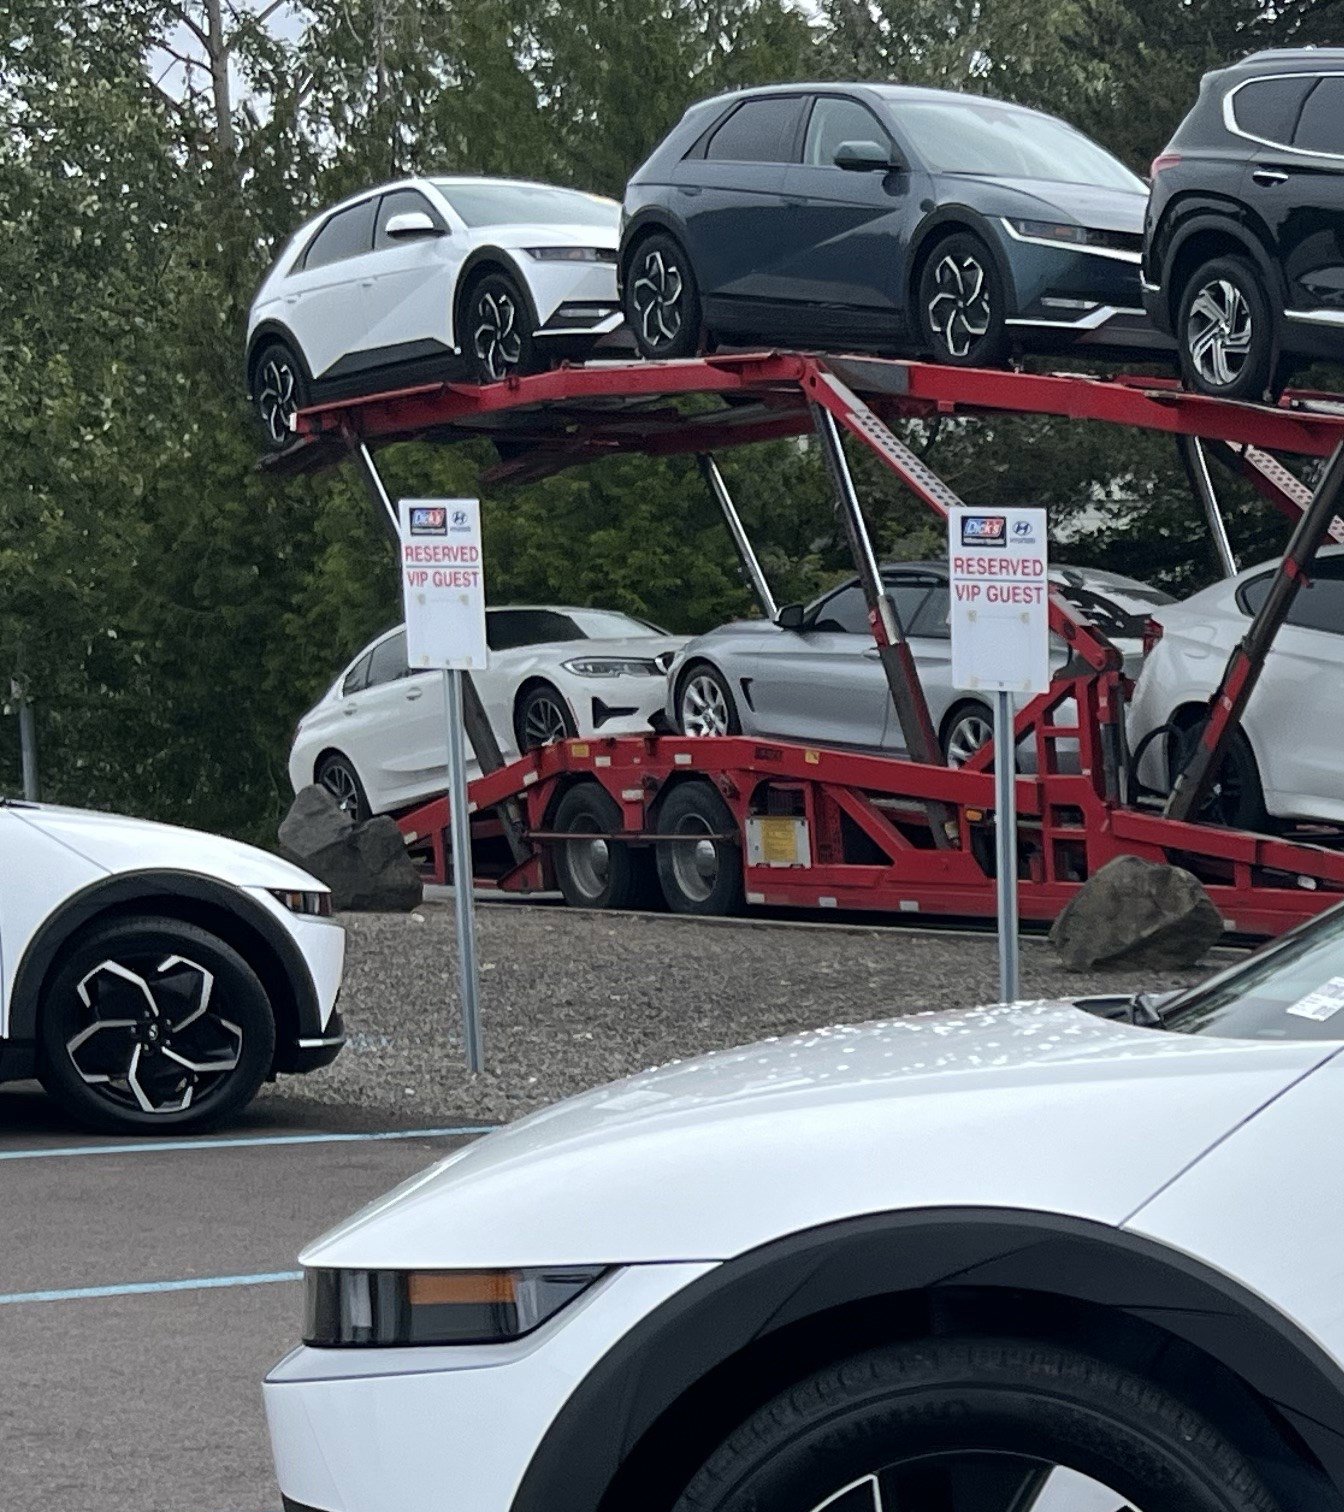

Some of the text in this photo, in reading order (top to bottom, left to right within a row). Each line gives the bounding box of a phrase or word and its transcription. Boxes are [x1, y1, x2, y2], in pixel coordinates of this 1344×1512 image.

[404, 545, 479, 563] RESERVED
[953, 557, 1044, 576] RESERVED
[407, 571, 480, 588] VIP GUEST
[955, 584, 1044, 604] VIP GUEST
